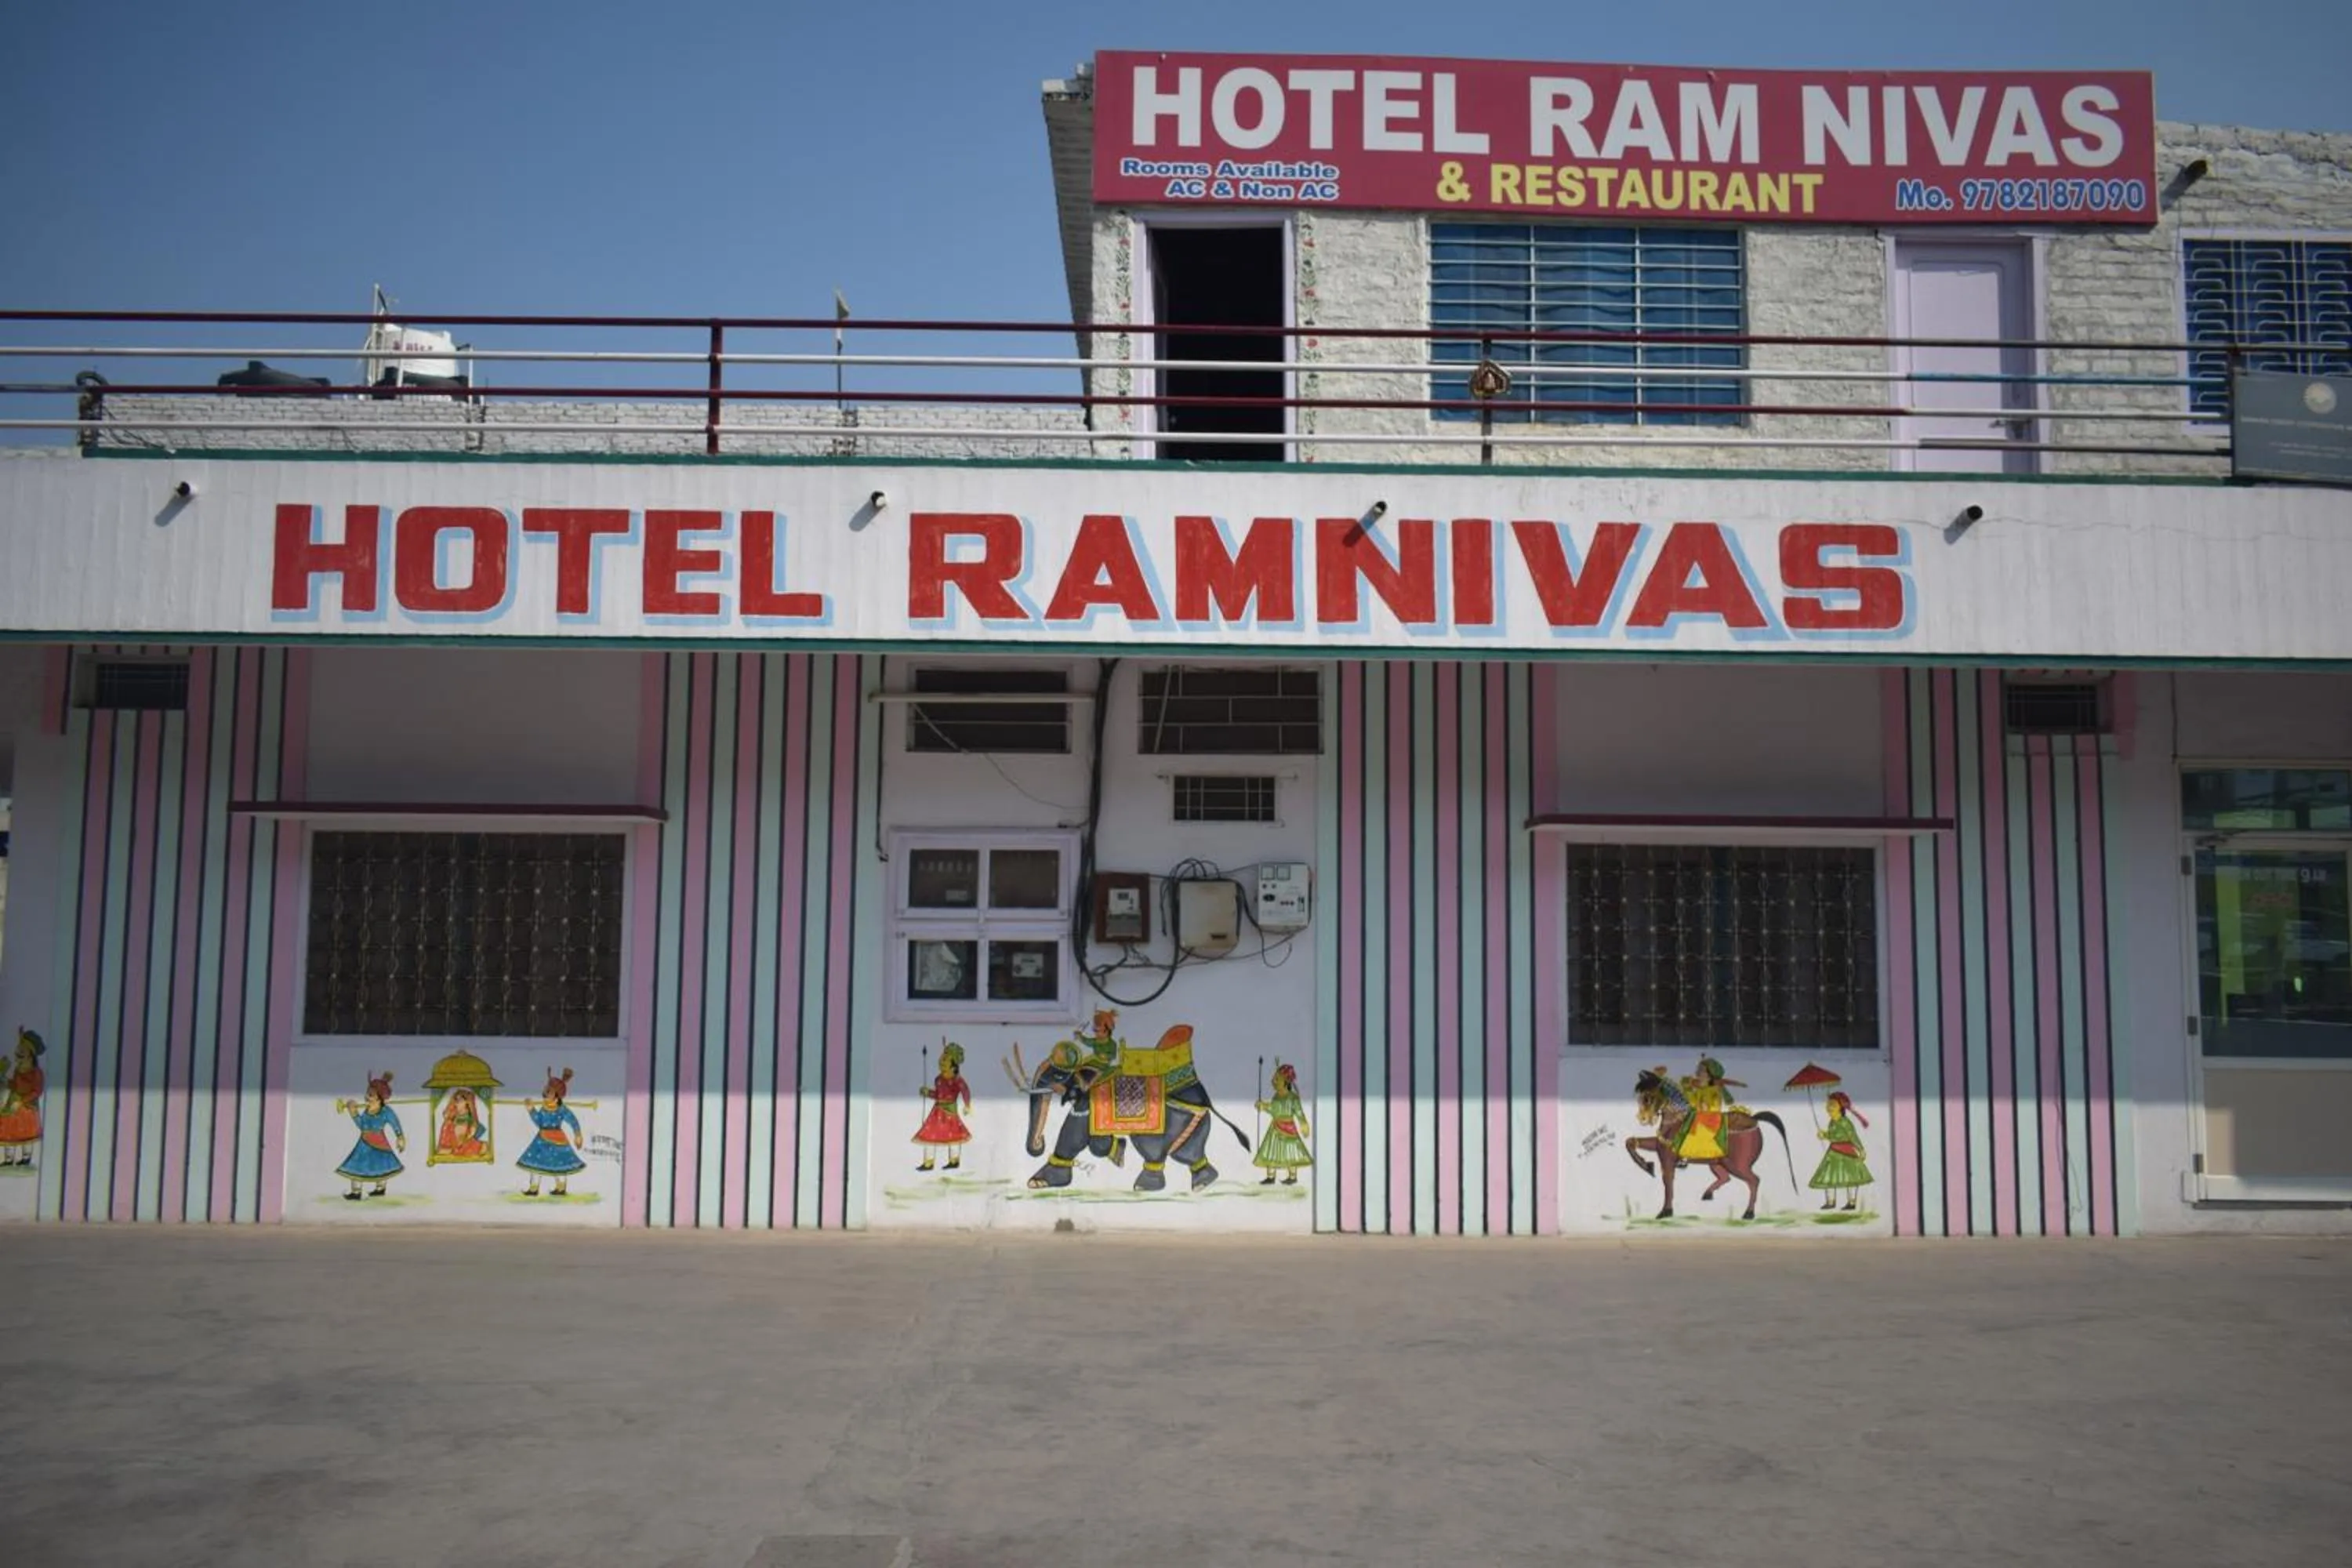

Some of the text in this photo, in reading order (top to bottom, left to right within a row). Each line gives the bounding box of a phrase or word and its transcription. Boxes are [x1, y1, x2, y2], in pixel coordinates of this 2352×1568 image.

[1132, 65, 2124, 167] HOTEL RAM NIVAS
[1121, 158, 1339, 180] Rooms Available
[1165, 180, 1340, 200] AC & Non AC
[1436, 161, 1824, 213] & RESTAURANT
[1895, 177, 2146, 212] Mo. 9782187090
[271, 504, 1916, 640] HOTEL RAMNIVAS
